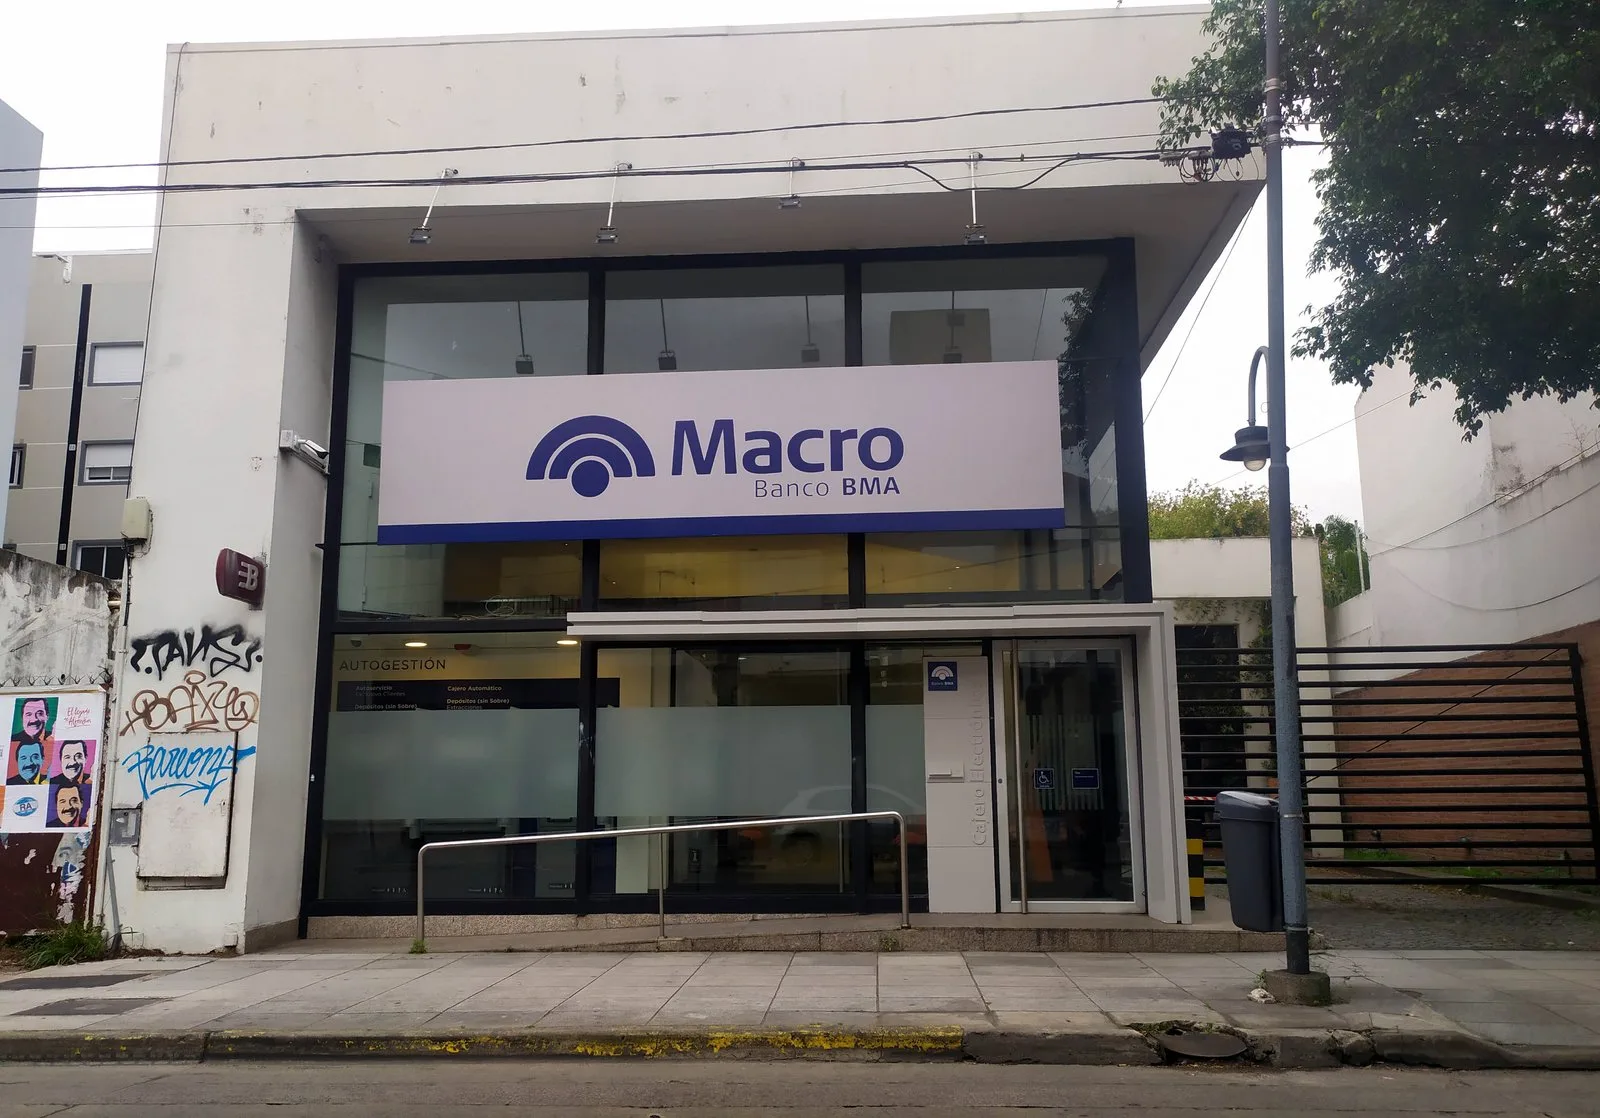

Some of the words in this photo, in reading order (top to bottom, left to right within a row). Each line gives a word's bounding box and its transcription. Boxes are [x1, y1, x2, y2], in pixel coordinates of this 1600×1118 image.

[671, 419, 904, 476] Macro
[755, 479, 829, 498] Banco
[842, 476, 900, 496] BMA
[339, 657, 446, 671] AUTOGESTIÓN
[968, 682, 985, 783] Electróni
[19, 802, 32, 812] RA
[970, 789, 989, 846] Cajero
